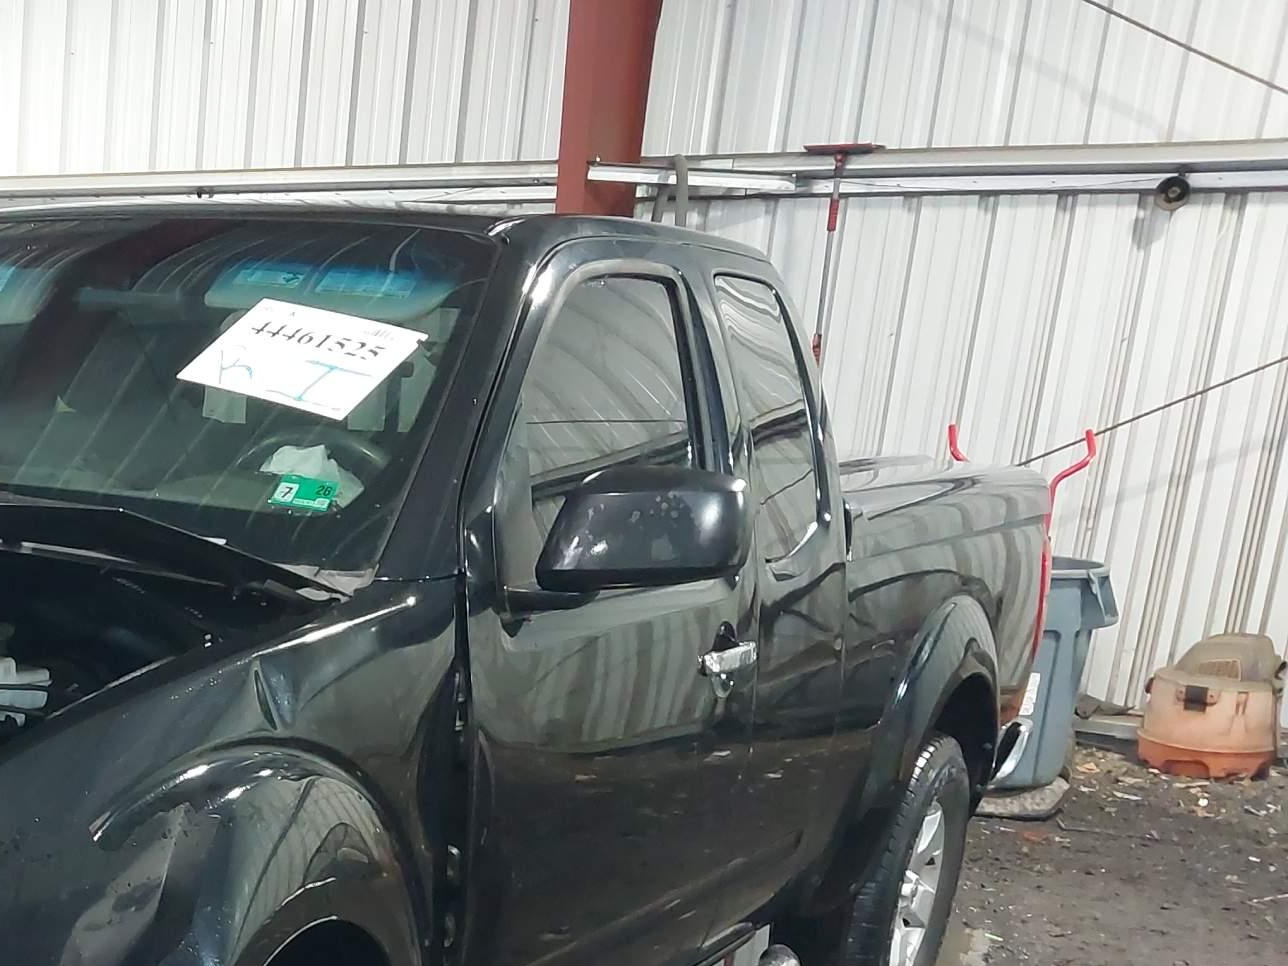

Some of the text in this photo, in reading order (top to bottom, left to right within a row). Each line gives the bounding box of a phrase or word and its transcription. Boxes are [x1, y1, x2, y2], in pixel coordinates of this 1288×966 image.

[251, 321, 387, 361] 44461525
[281, 485, 333, 498] 7 26
